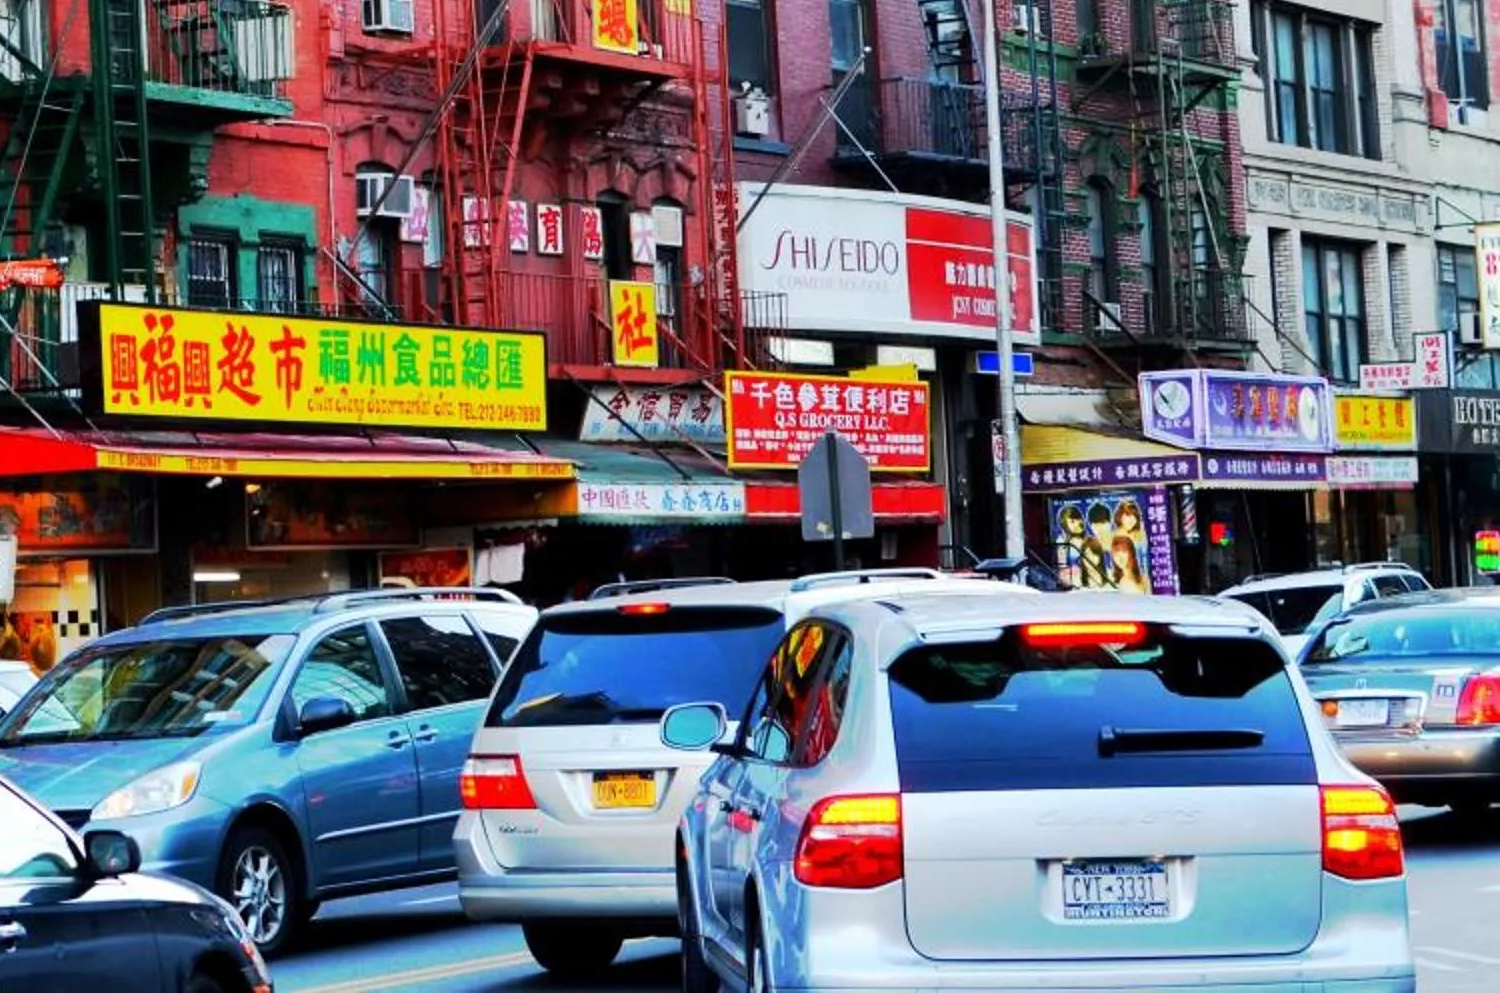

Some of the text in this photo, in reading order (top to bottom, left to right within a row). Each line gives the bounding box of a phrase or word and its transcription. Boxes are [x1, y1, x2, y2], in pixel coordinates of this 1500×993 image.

[760, 229, 900, 277] SHISEIDO
[616, 290, 653, 360] 社
[799, 413, 863, 430] GROCERY
